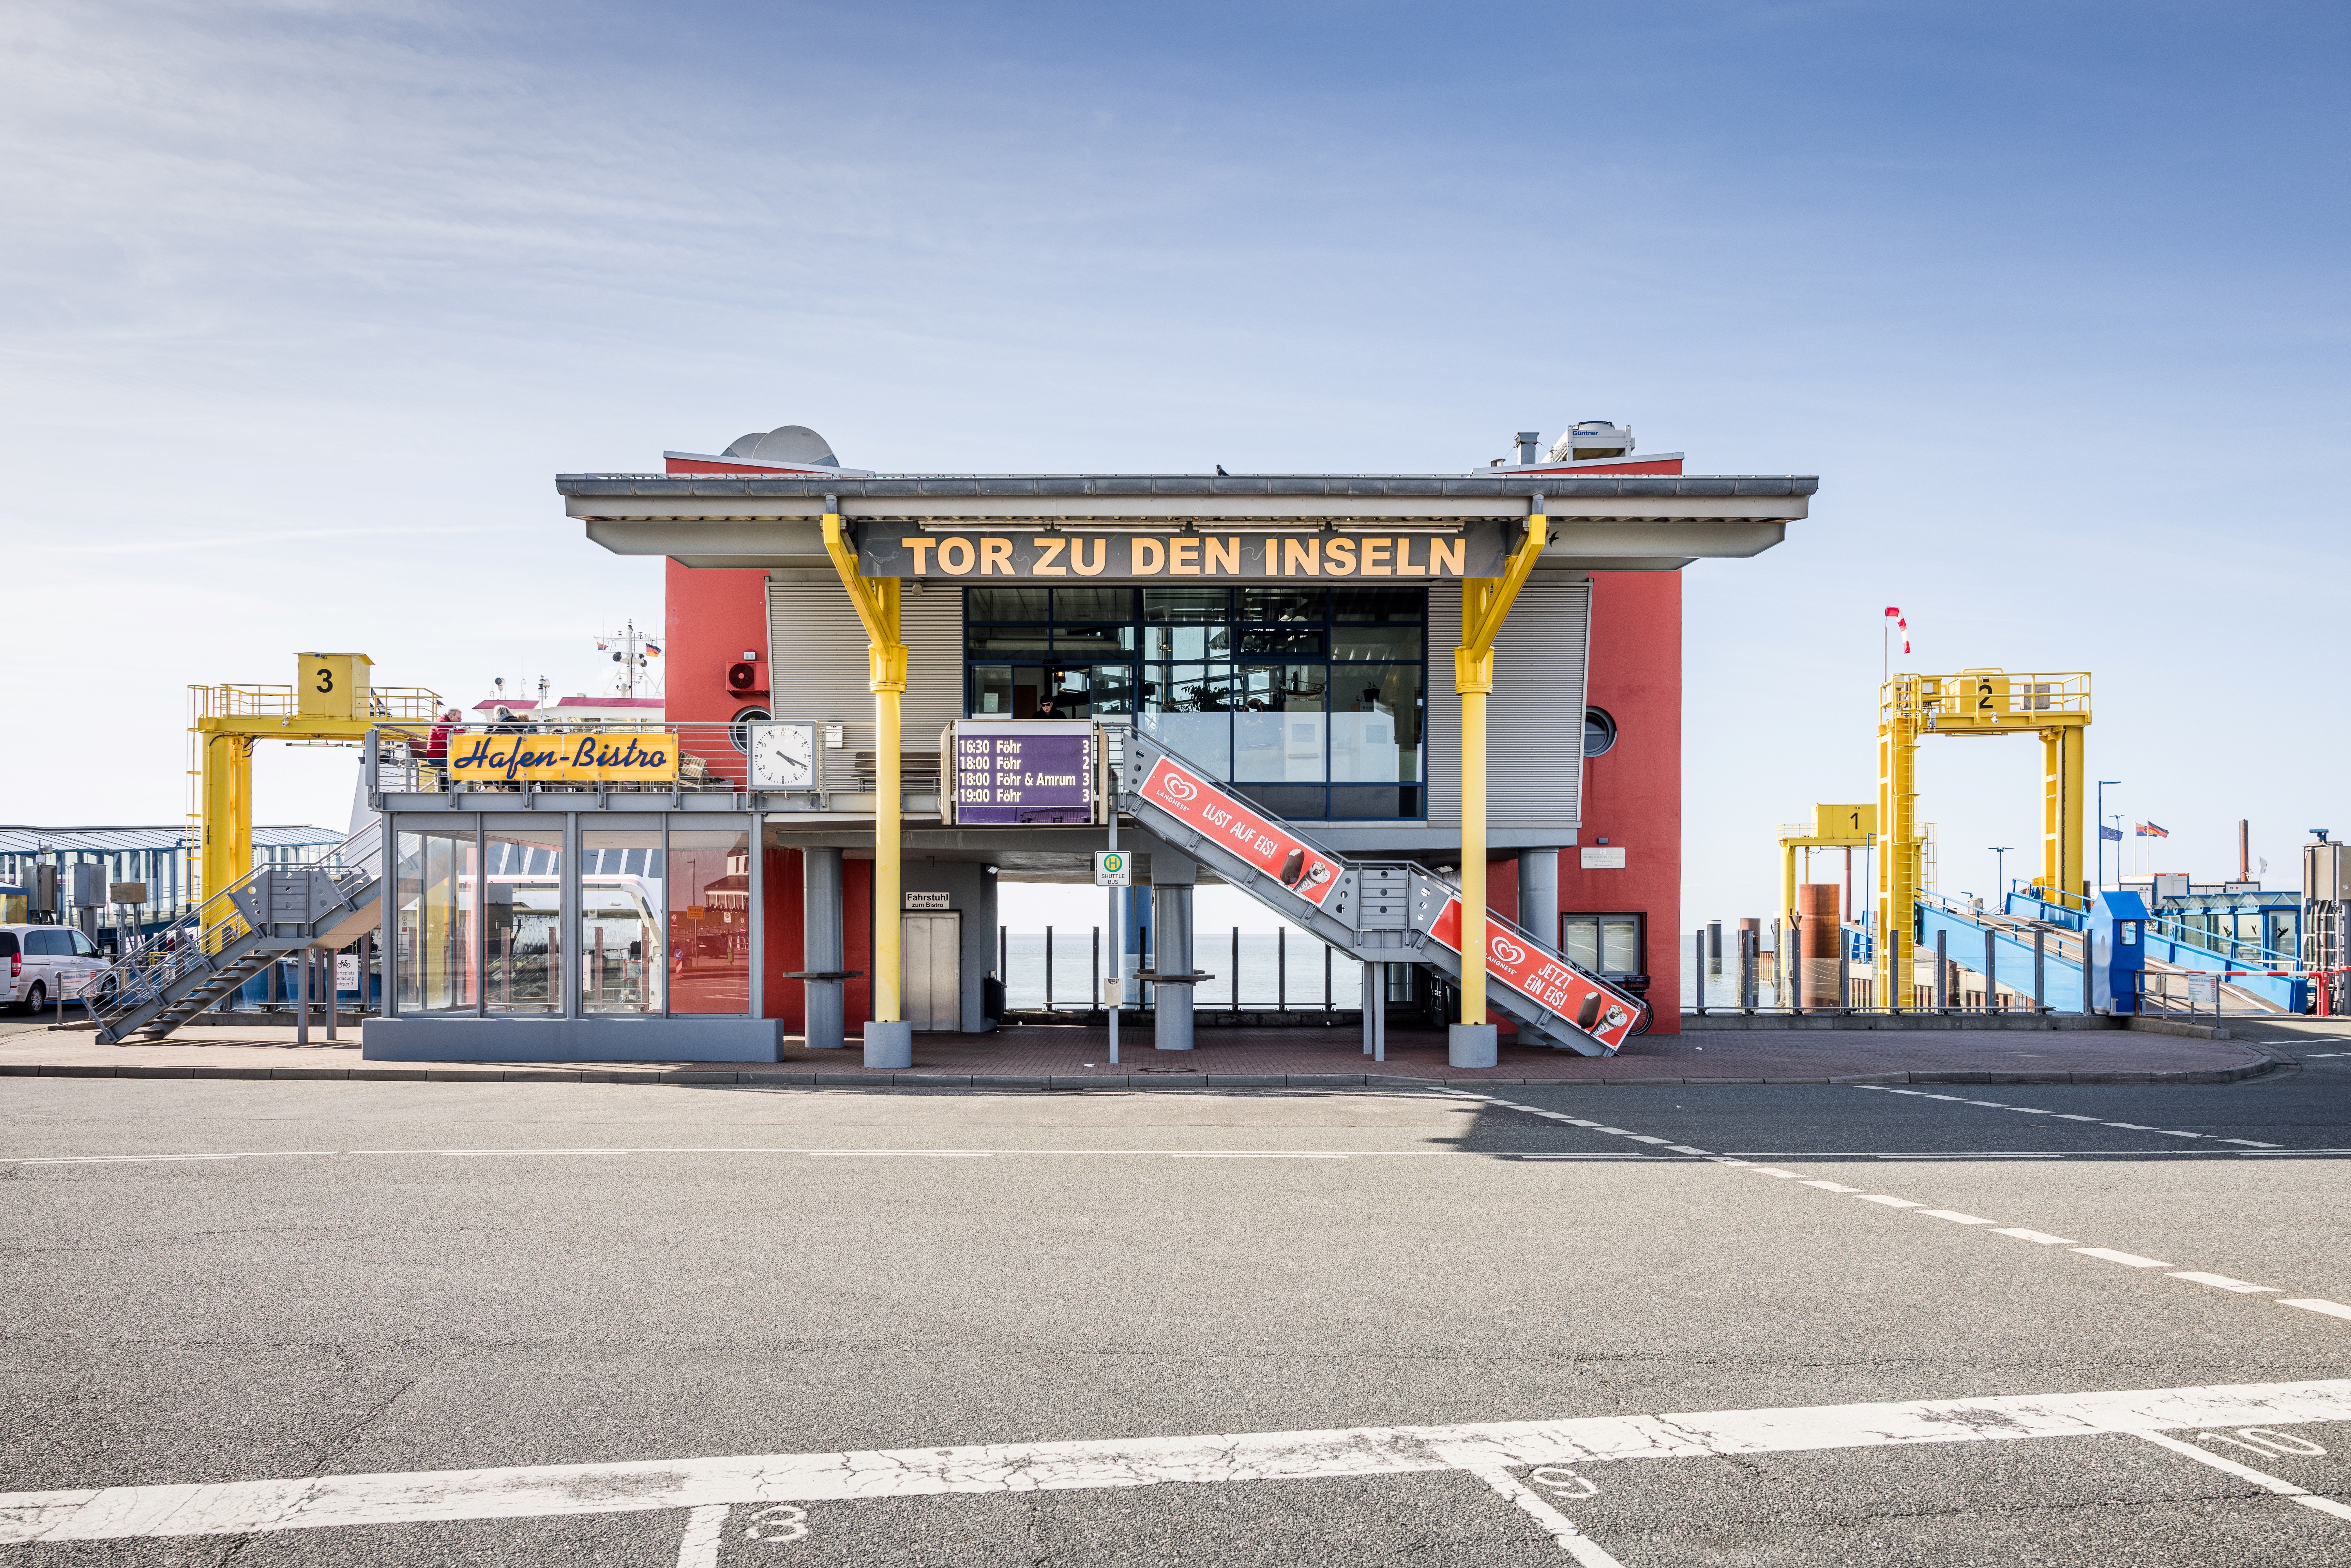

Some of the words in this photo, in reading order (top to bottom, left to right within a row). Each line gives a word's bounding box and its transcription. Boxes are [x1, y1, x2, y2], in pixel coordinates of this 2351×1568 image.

[902, 537, 1016, 576] TOR
[1032, 538, 1106, 576] ZU
[1131, 537, 1240, 575] DEN
[1265, 537, 1465, 576] INSELN
[316, 668, 333, 693] 3
[1979, 684, 1993, 709] 2
[454, 736, 666, 780] Hafen-Bistro
[960, 740, 990, 753] 16:30
[997, 740, 1022, 753] Föhr
[1082, 740, 1089, 753] 3
[960, 756, 990, 769] 18:00
[997, 756, 1022, 769] Föhr
[1082, 756, 1089, 769] 2
[960, 772, 990, 786] 18:00
[997, 772, 1022, 786] Föhr
[1024, 772, 1033, 786] &
[1036, 772, 1076, 786] Amrum
[1082, 772, 1089, 786] 3
[960, 789, 990, 802] 19:00
[997, 789, 1022, 802] Föhr
[1082, 789, 1089, 802] 3
[1202, 803, 1233, 828] LUST
[1229, 821, 1256, 842] AUF
[1850, 812, 1859, 830] 1
[1538, 963, 1574, 989] JETZT
[2197, 1428, 2327, 1458] 10
[1533, 1467, 1598, 1498] 9
